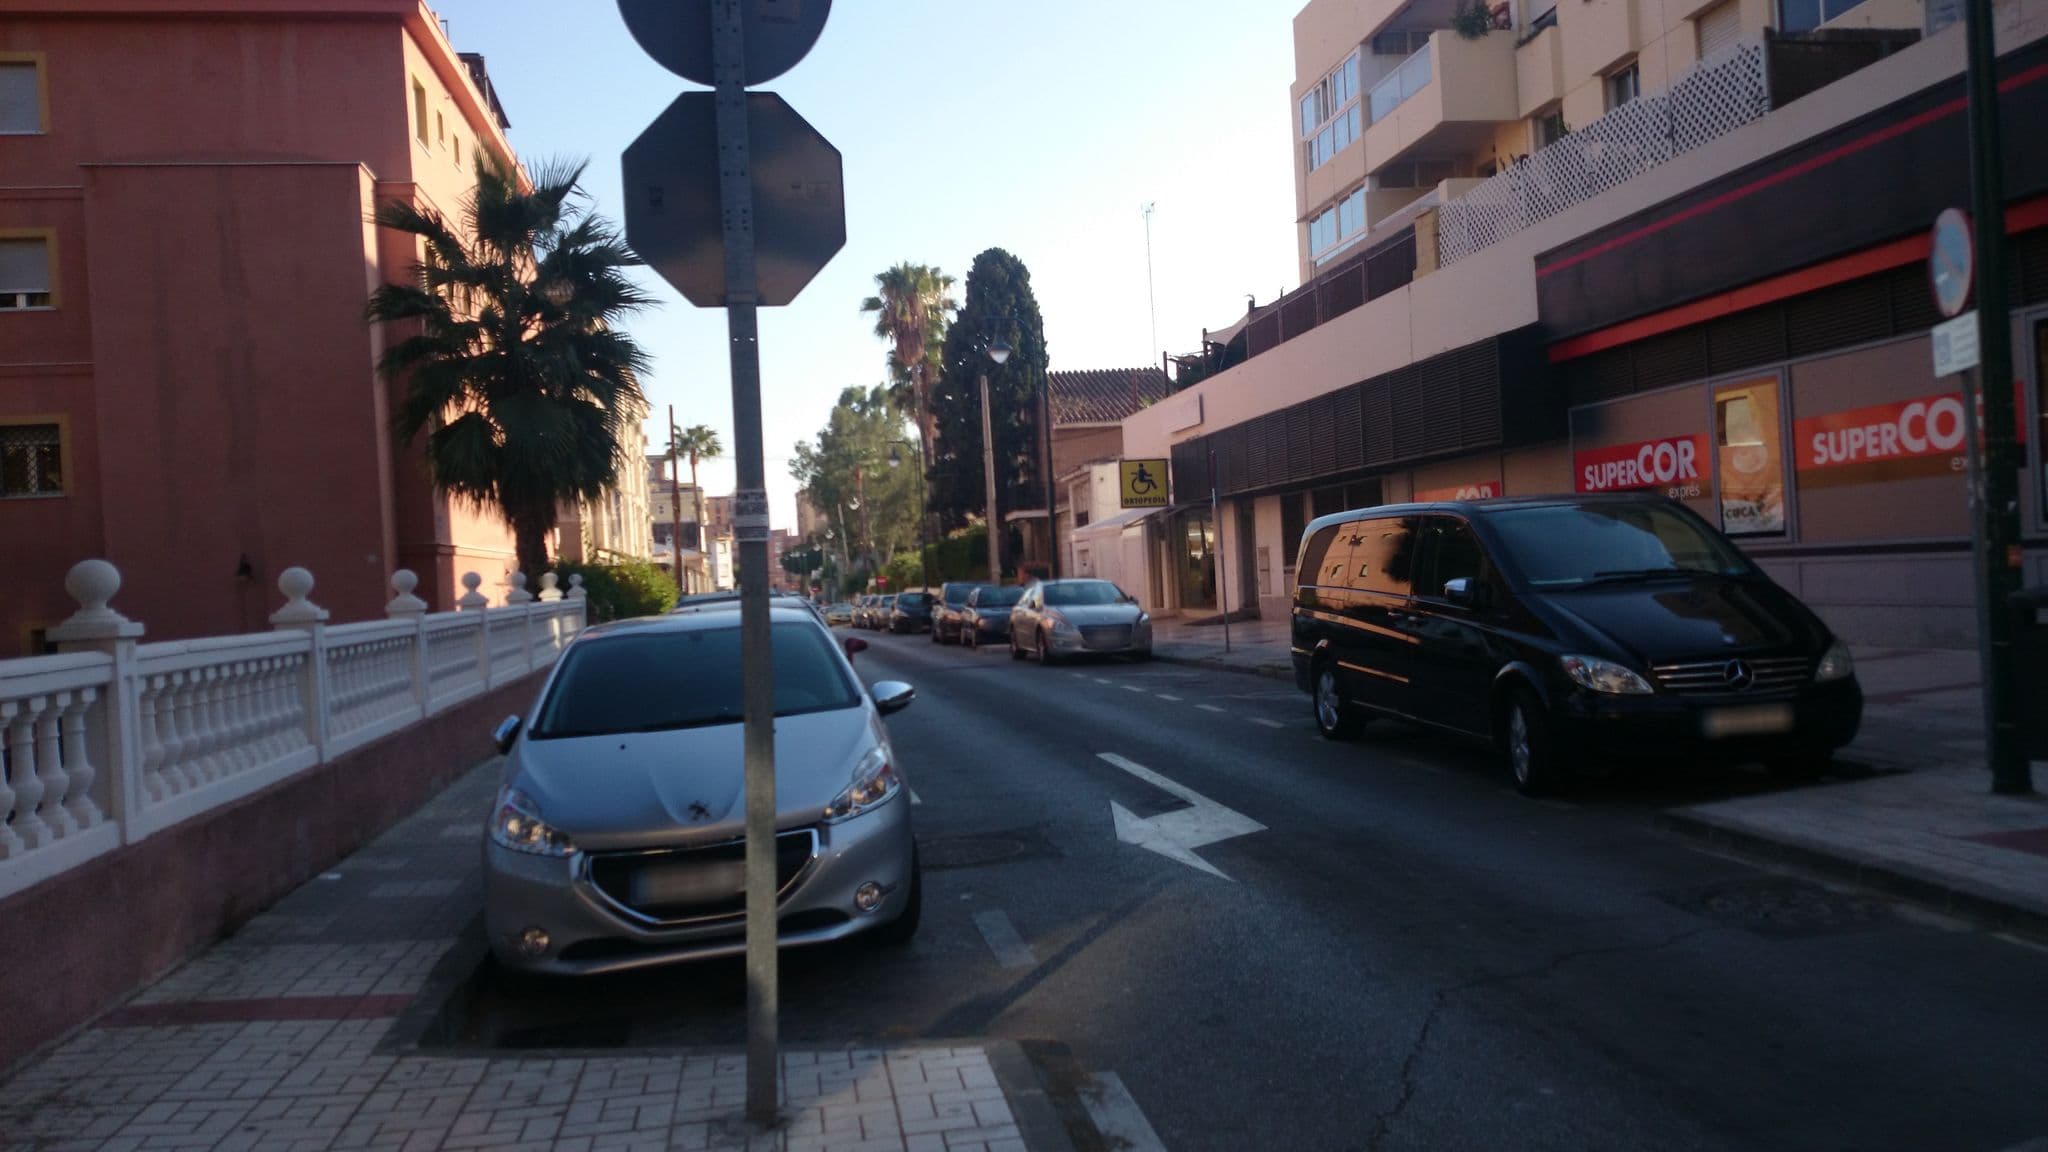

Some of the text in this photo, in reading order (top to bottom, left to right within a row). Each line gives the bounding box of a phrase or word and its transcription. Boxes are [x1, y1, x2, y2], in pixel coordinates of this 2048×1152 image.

[1812, 397, 1985, 466] SUPERCO
[1584, 440, 1697, 491] SUPERCOR
[1124, 496, 1166, 505] ORTOPEDIA
